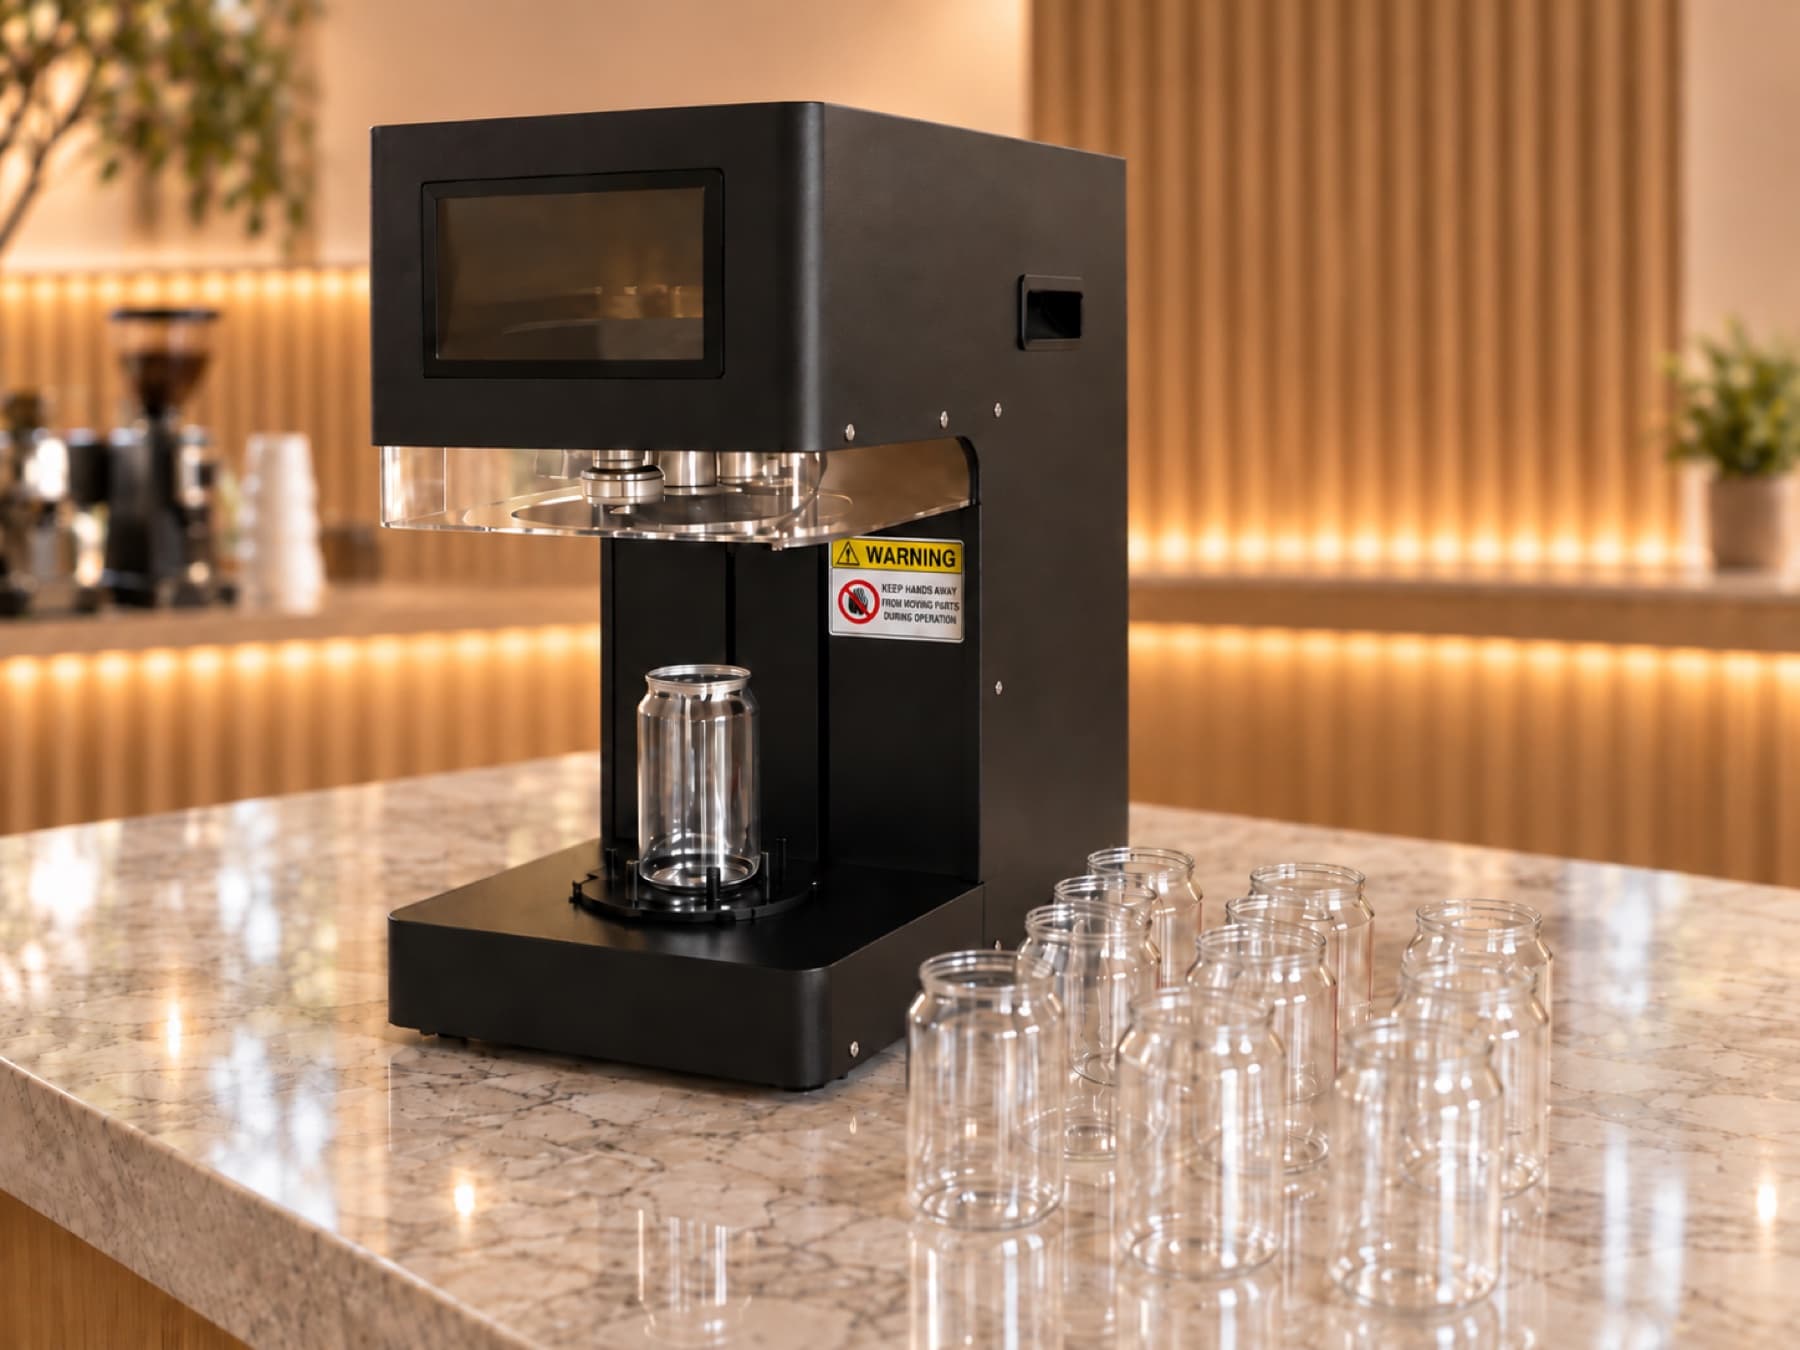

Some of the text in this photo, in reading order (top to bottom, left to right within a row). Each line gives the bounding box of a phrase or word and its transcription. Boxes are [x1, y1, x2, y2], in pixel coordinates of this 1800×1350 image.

[866, 546, 955, 567] WARNING
[882, 584, 957, 595] KEEP HANDS AWAY
[881, 598, 902, 608] FROM
[903, 599, 933, 610] MOVING
[884, 612, 957, 624] DURING OPERATION
